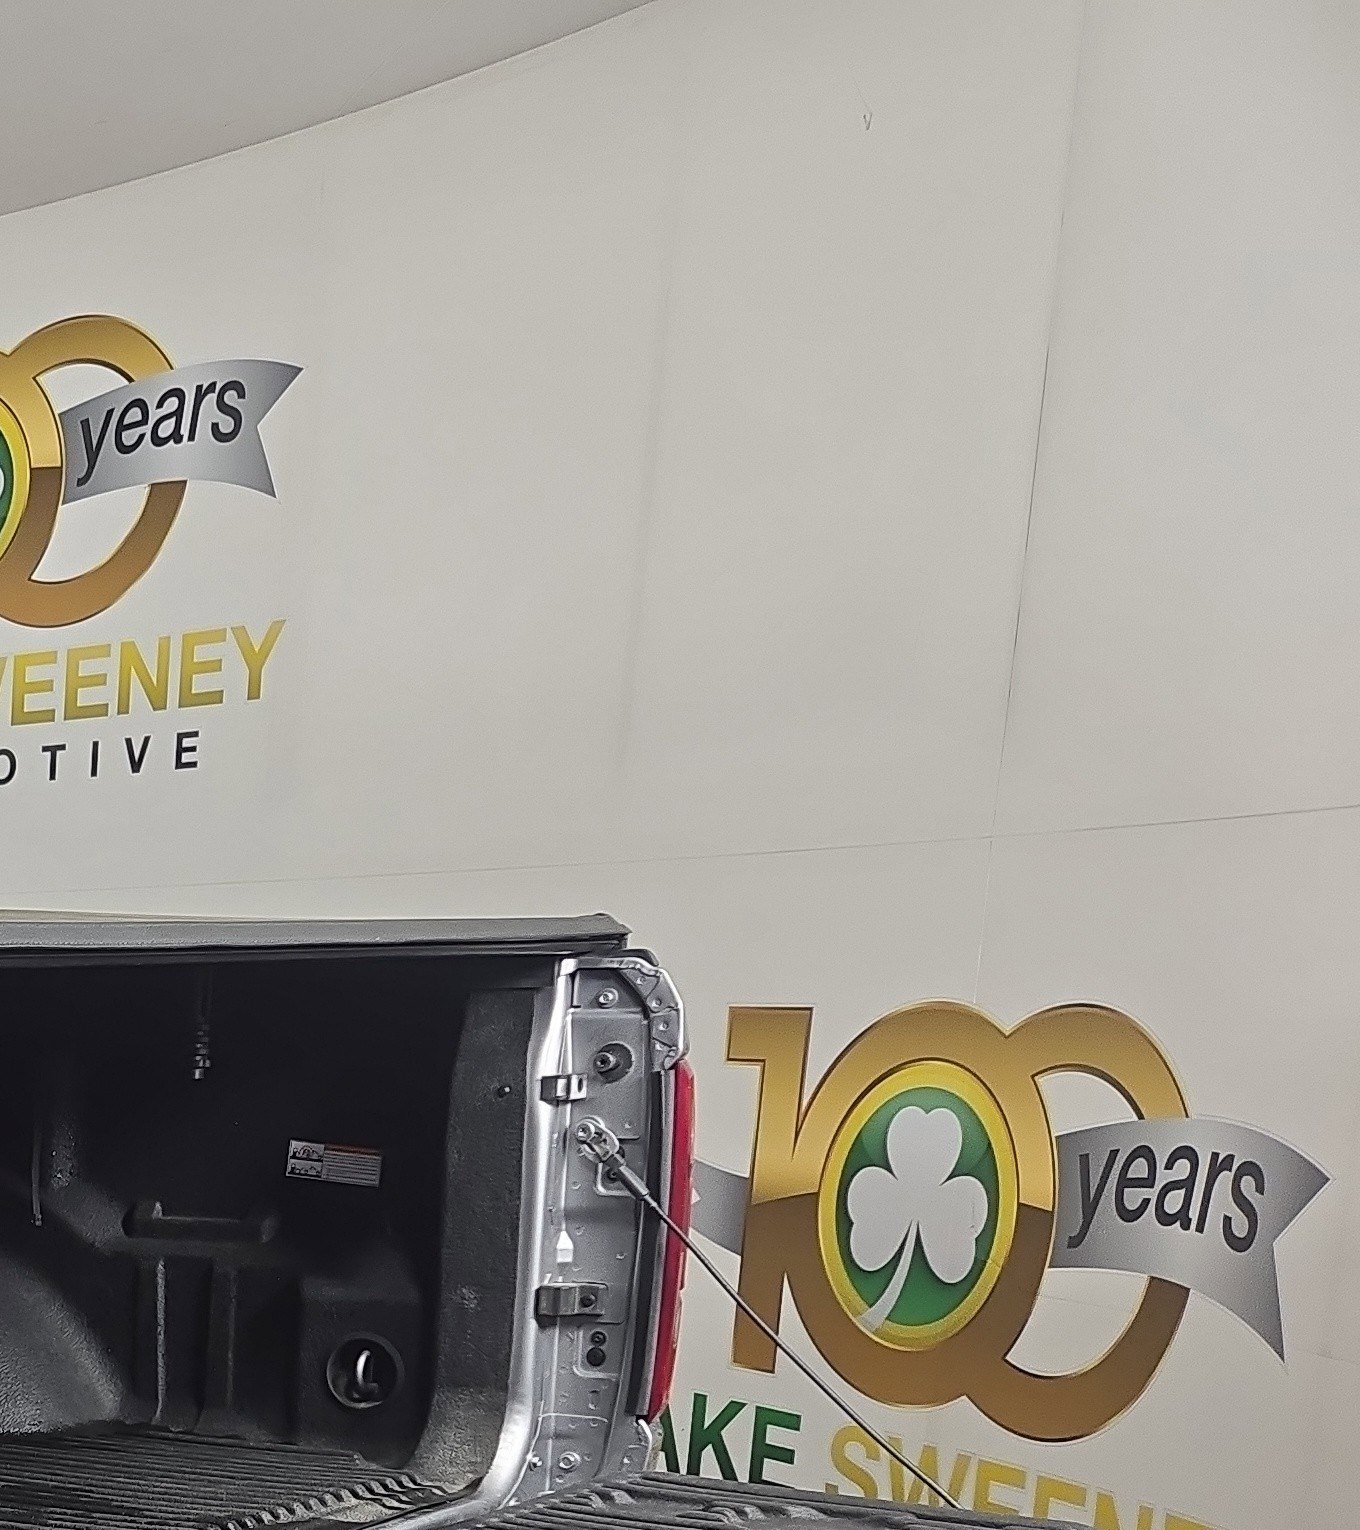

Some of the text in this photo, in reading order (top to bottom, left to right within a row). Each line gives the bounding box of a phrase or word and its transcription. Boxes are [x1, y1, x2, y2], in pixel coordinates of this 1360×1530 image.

[76, 379, 247, 488] years
[726, 999, 1266, 1443] 100 years
